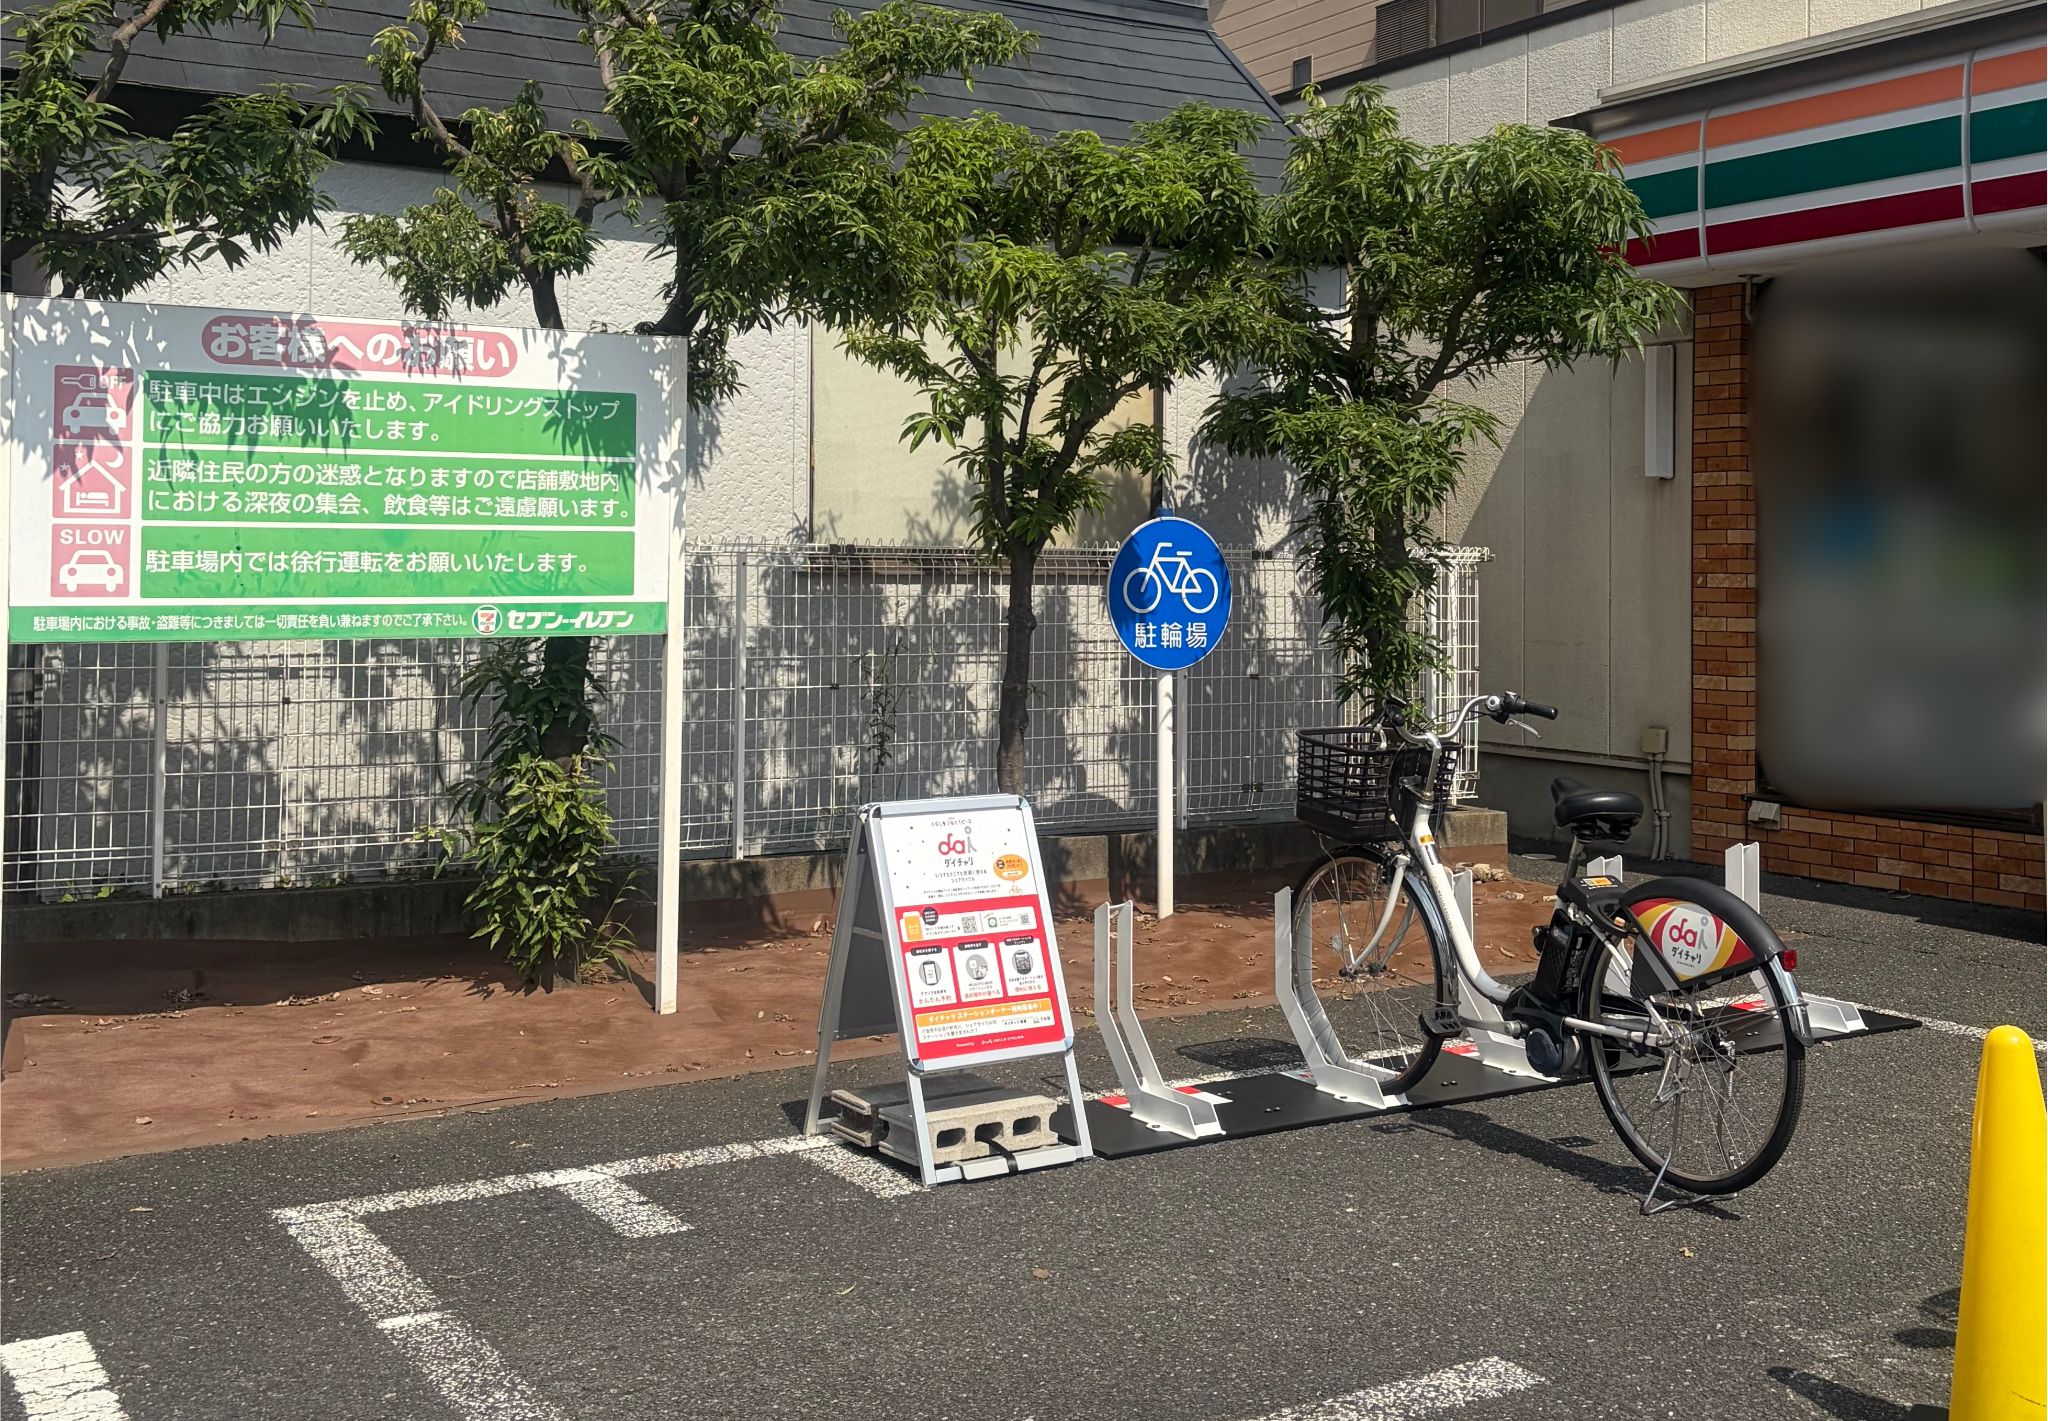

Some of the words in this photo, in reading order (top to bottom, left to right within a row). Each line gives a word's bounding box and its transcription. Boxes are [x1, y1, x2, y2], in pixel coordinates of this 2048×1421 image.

[210, 322, 509, 372] お客様へのお願い
[99, 376, 127, 390] OFF
[149, 380, 620, 420] 駐車中はエンジンを止め、アイドリングストップ
[150, 413, 440, 442] にご協力お願いいたします。
[147, 459, 619, 493] 近隣住民の方の迷惑となりますので店舗敷地内
[149, 490, 628, 519] における深夜の集会、飲食等はご遠慮願います。
[60, 529, 125, 545] SLOW
[145, 551, 588, 574] 駐車場内では徐行運転をお願いいたします。
[1134, 622, 1208, 649] 駐輪場
[944, 857, 974, 868] ダイチャリ
[1671, 946, 1702, 965] ダイチャリ
